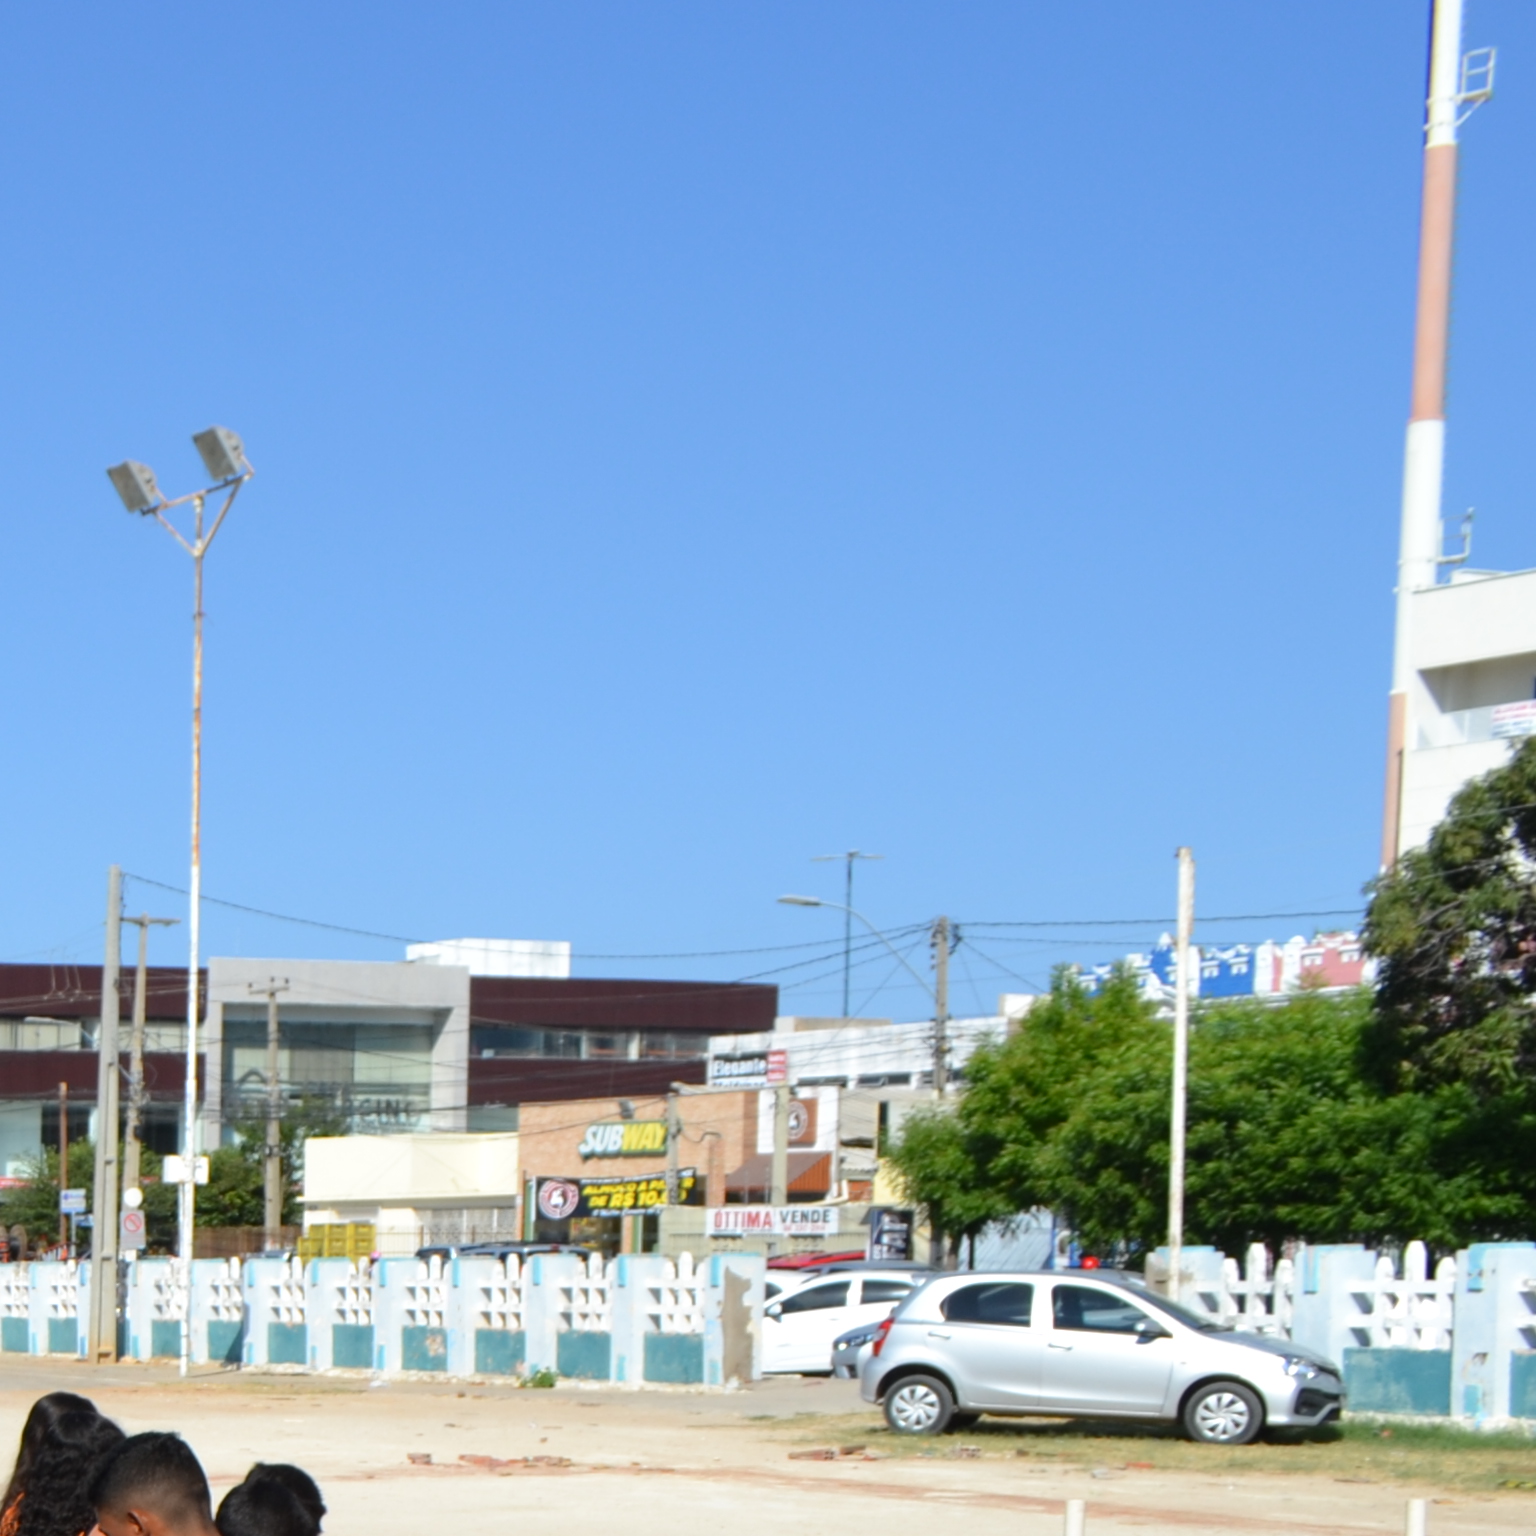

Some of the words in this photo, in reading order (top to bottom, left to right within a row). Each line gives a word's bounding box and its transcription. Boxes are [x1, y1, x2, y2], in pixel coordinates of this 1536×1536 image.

[579, 1122, 667, 1153] SUBWAY
[714, 1209, 773, 1229] ÓTTIMA
[779, 1208, 832, 1223] VENDE
